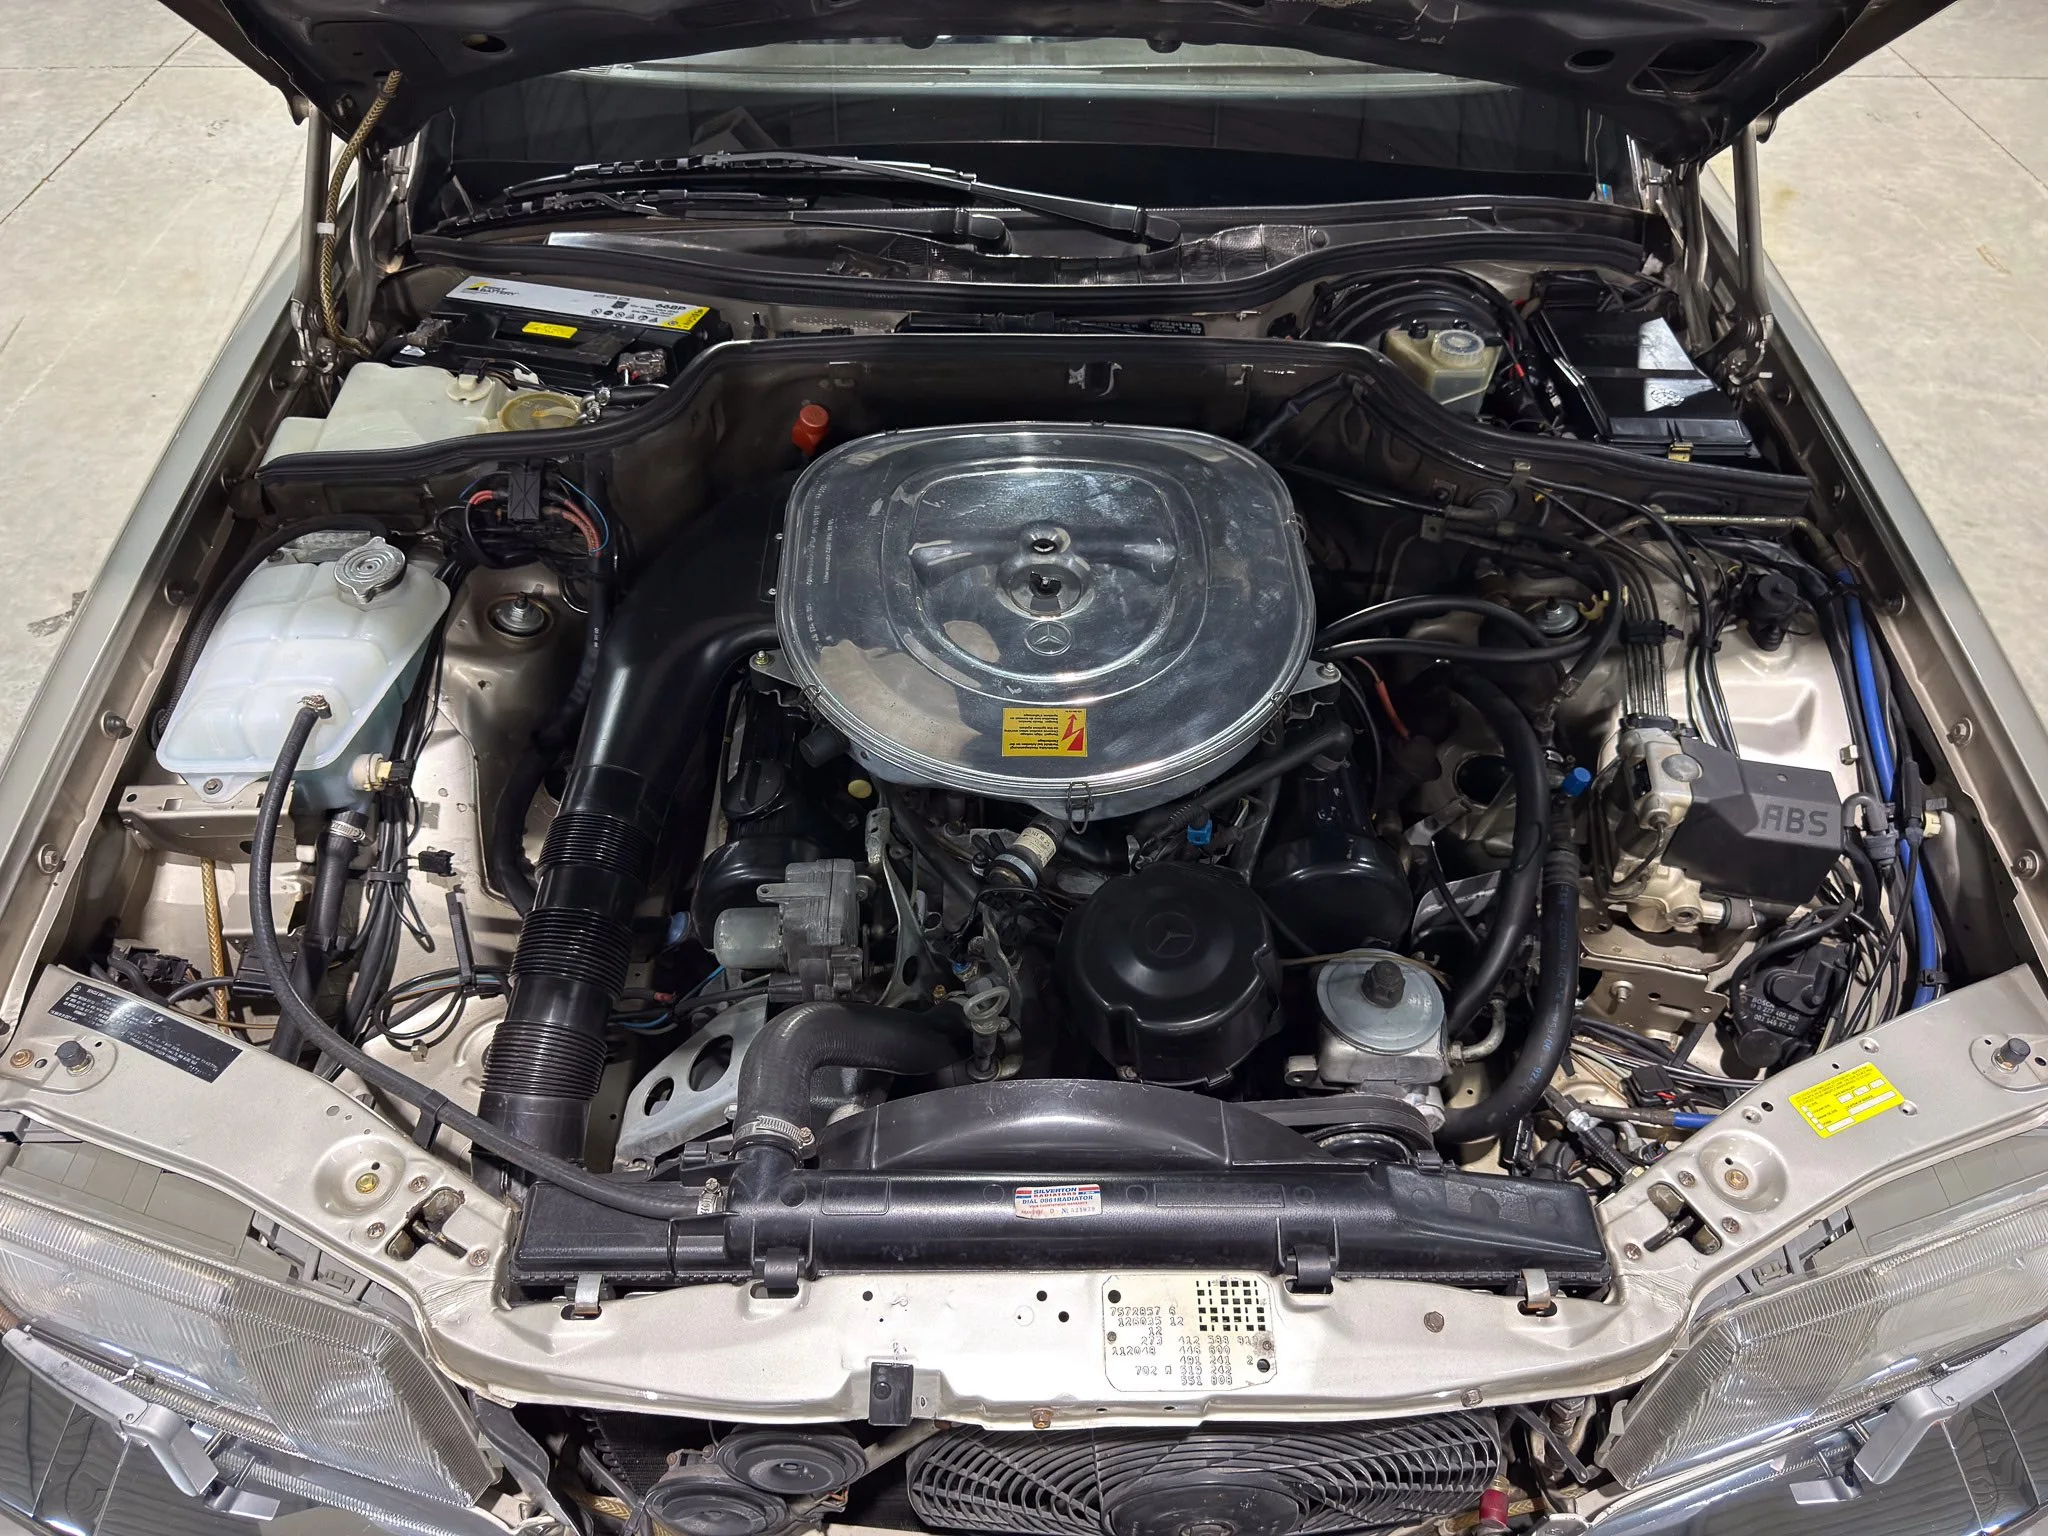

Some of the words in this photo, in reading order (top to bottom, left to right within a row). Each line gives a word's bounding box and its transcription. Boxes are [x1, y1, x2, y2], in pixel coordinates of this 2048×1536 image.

[1761, 803, 1828, 837] ABS
[1752, 997, 1775, 1008] BOSCH
[1169, 1306, 1176, 1316] 6
[1118, 1316, 1162, 1327] 126035
[1170, 1317, 1184, 1326] 12
[1149, 1326, 1162, 1336] 12
[1209, 1355, 1231, 1365] 241
[1247, 1356, 1254, 1365] 2
[1135, 1366, 1158, 1376] 702
[1210, 1365, 1232, 1376] 242
